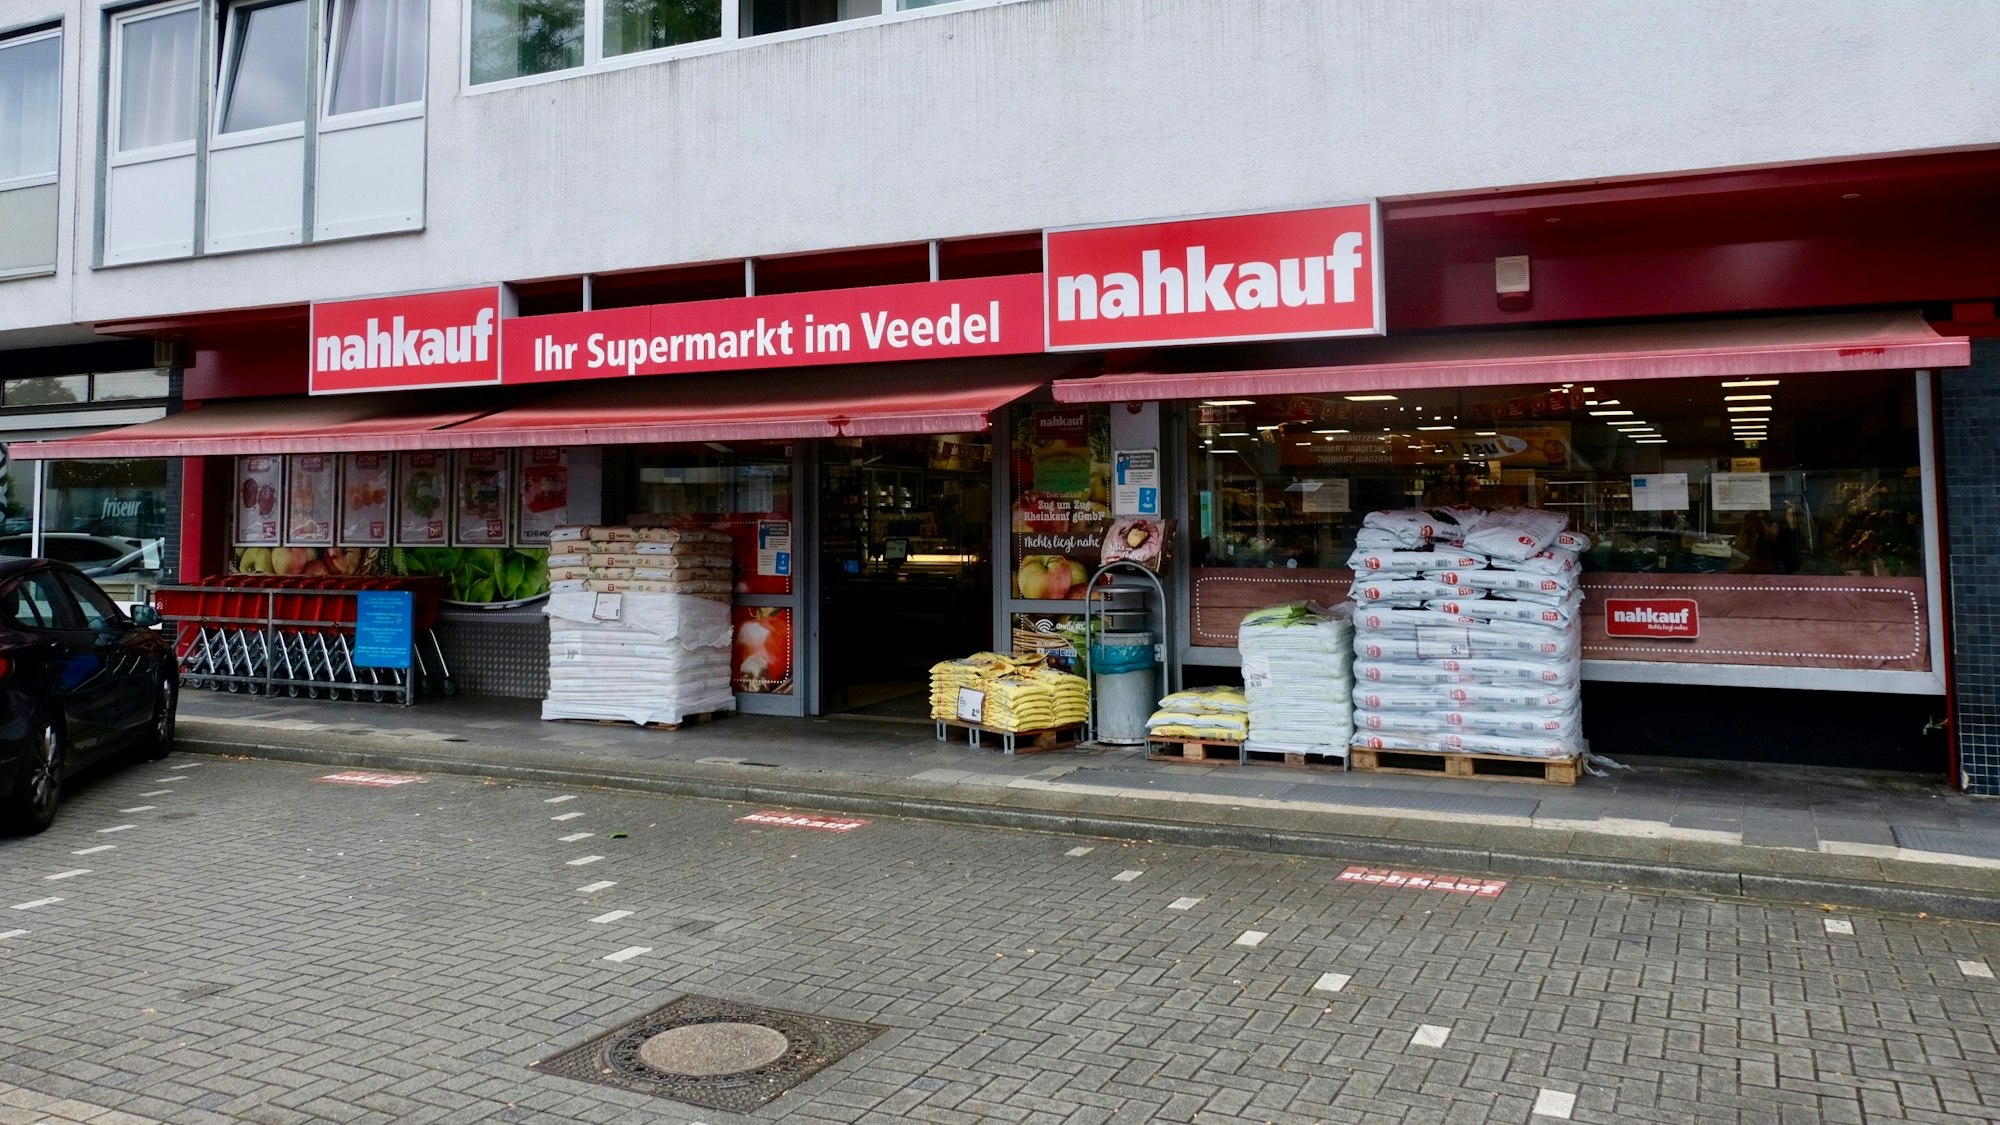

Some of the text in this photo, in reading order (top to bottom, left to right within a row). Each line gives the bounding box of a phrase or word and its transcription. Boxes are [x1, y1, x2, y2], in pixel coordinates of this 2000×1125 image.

[1057, 231, 1363, 321] nahkauf
[317, 307, 494, 371] nahkauf
[535, 300, 1000, 376] Ihr Supermarkt im Veedel
[1040, 414, 1084, 427] nahkauf
[101, 497, 142, 520] friseur
[1038, 500, 1091, 511] Zug um Zug
[1024, 511, 1070, 521] Rheinkauf
[1024, 534, 1052, 549] Nichts
[1052, 534, 1076, 553] liegt
[1614, 607, 1689, 624] nahkauf
